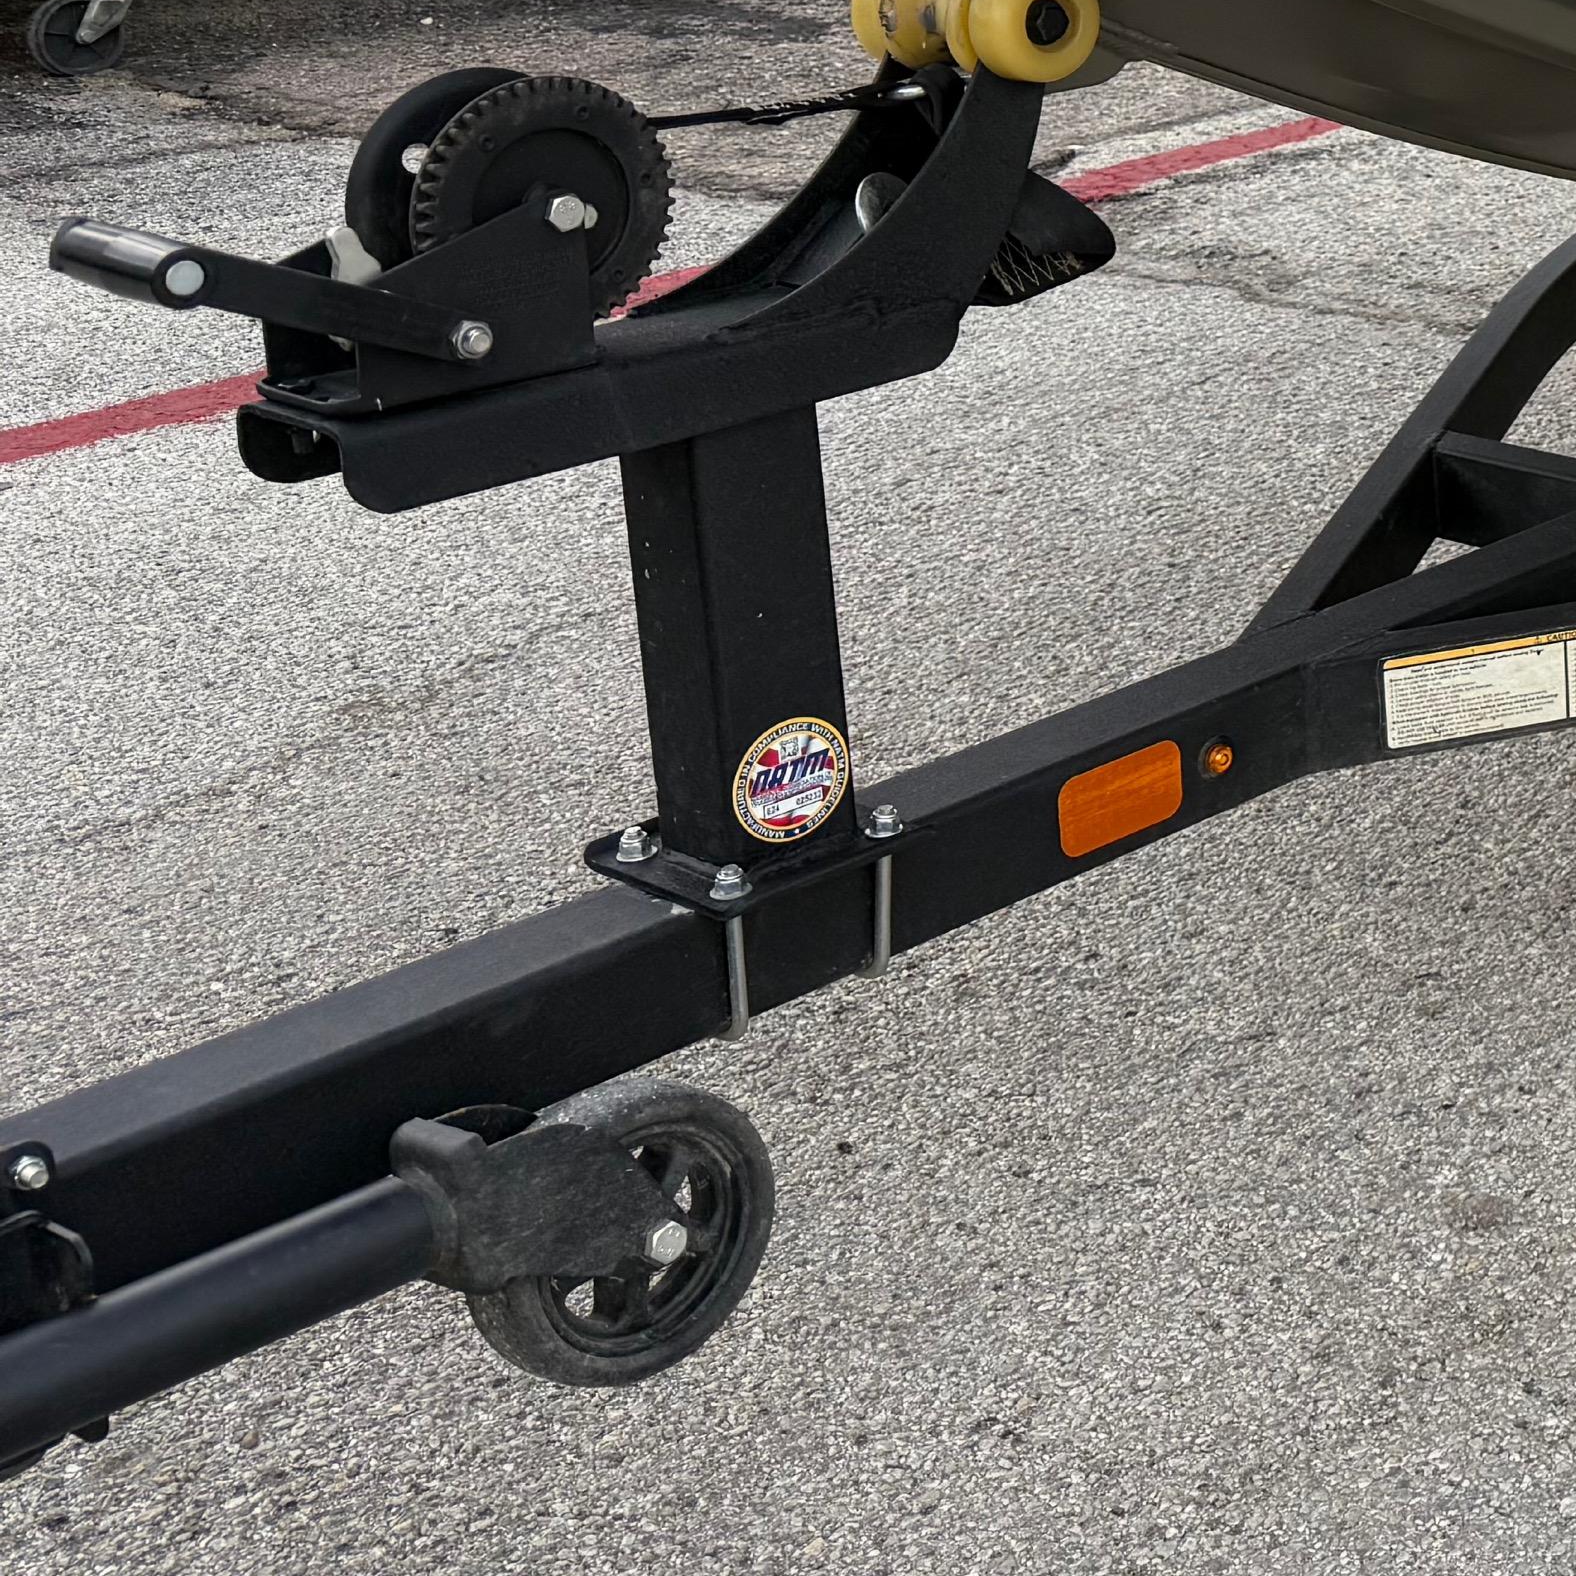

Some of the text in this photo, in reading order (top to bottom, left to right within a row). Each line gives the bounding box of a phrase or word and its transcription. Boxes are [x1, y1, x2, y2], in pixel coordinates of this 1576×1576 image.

[748, 722, 808, 762] COMPLIANCE
[811, 723, 835, 742] WITH
[742, 765, 750, 779] IN
[750, 748, 830, 798] NATM
[807, 772, 844, 828] GUIDELINES
